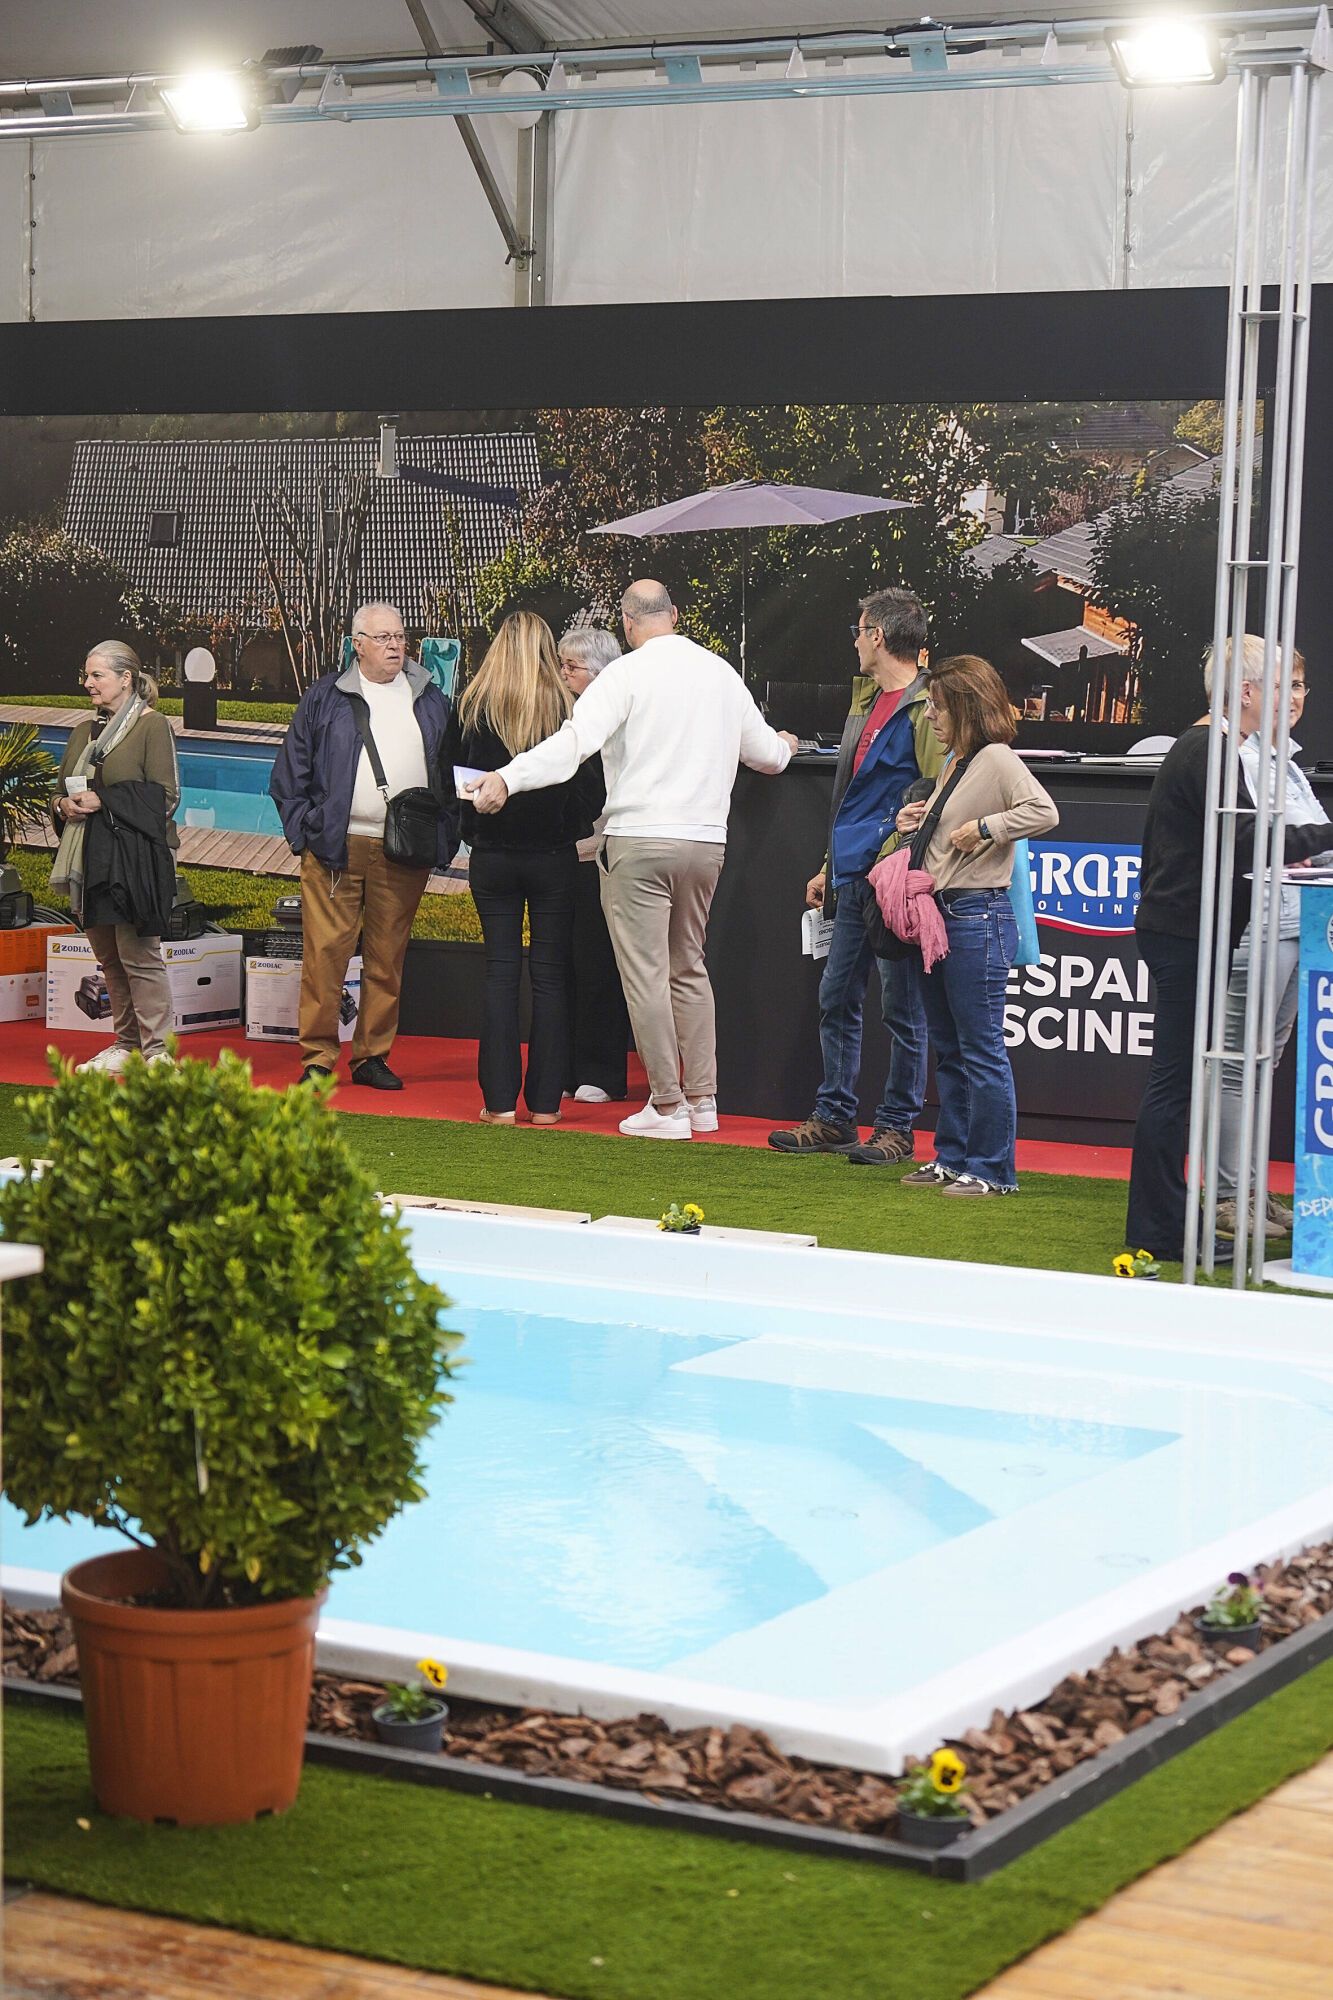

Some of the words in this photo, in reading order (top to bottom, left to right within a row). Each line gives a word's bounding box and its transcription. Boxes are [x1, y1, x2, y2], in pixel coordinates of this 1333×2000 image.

[1038, 900, 1064, 912] OL
[61, 945, 92, 953] ZODIAC
[173, 948, 196, 956] ZODIAC
[257, 961, 282, 969] ZODIAC
[1002, 1004, 1155, 1056] SCINE
[1297, 1197, 1333, 1217] DEP
